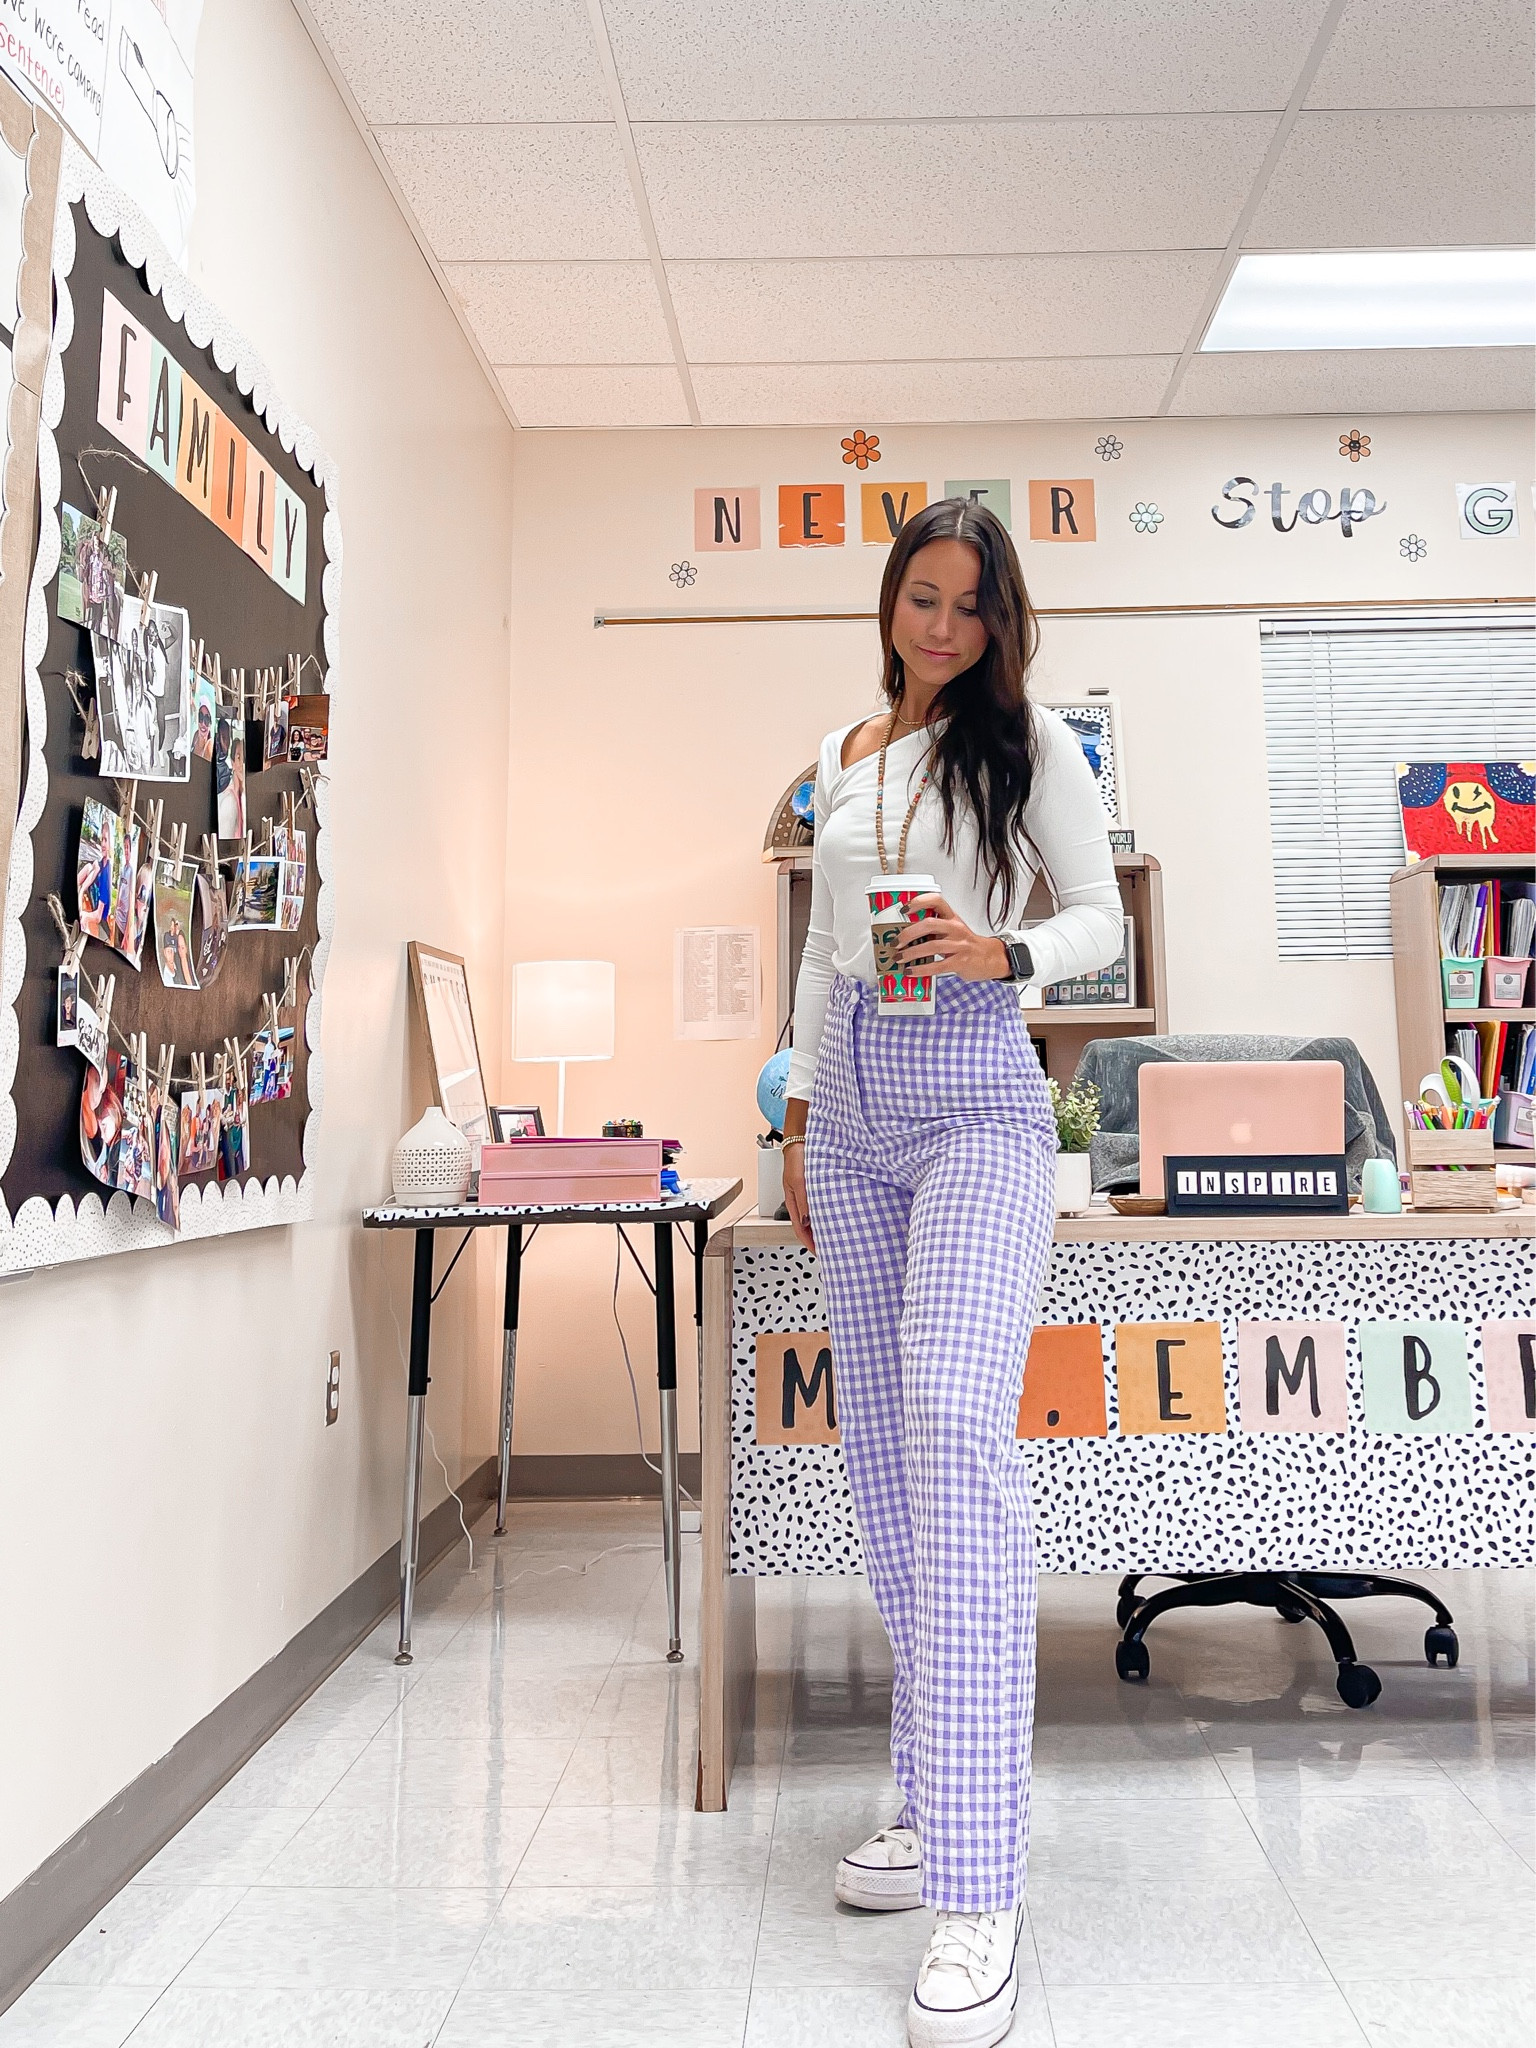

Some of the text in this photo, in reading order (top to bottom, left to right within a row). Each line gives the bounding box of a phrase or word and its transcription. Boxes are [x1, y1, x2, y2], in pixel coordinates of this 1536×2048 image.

[67, 54, 102, 116] camping
[116, 323, 298, 579] FAMILY
[714, 476, 1513, 544] NEVR Stop G
[1110, 832, 1132, 844] WORLD
[1186, 1176, 1331, 1193] INSPIRE
